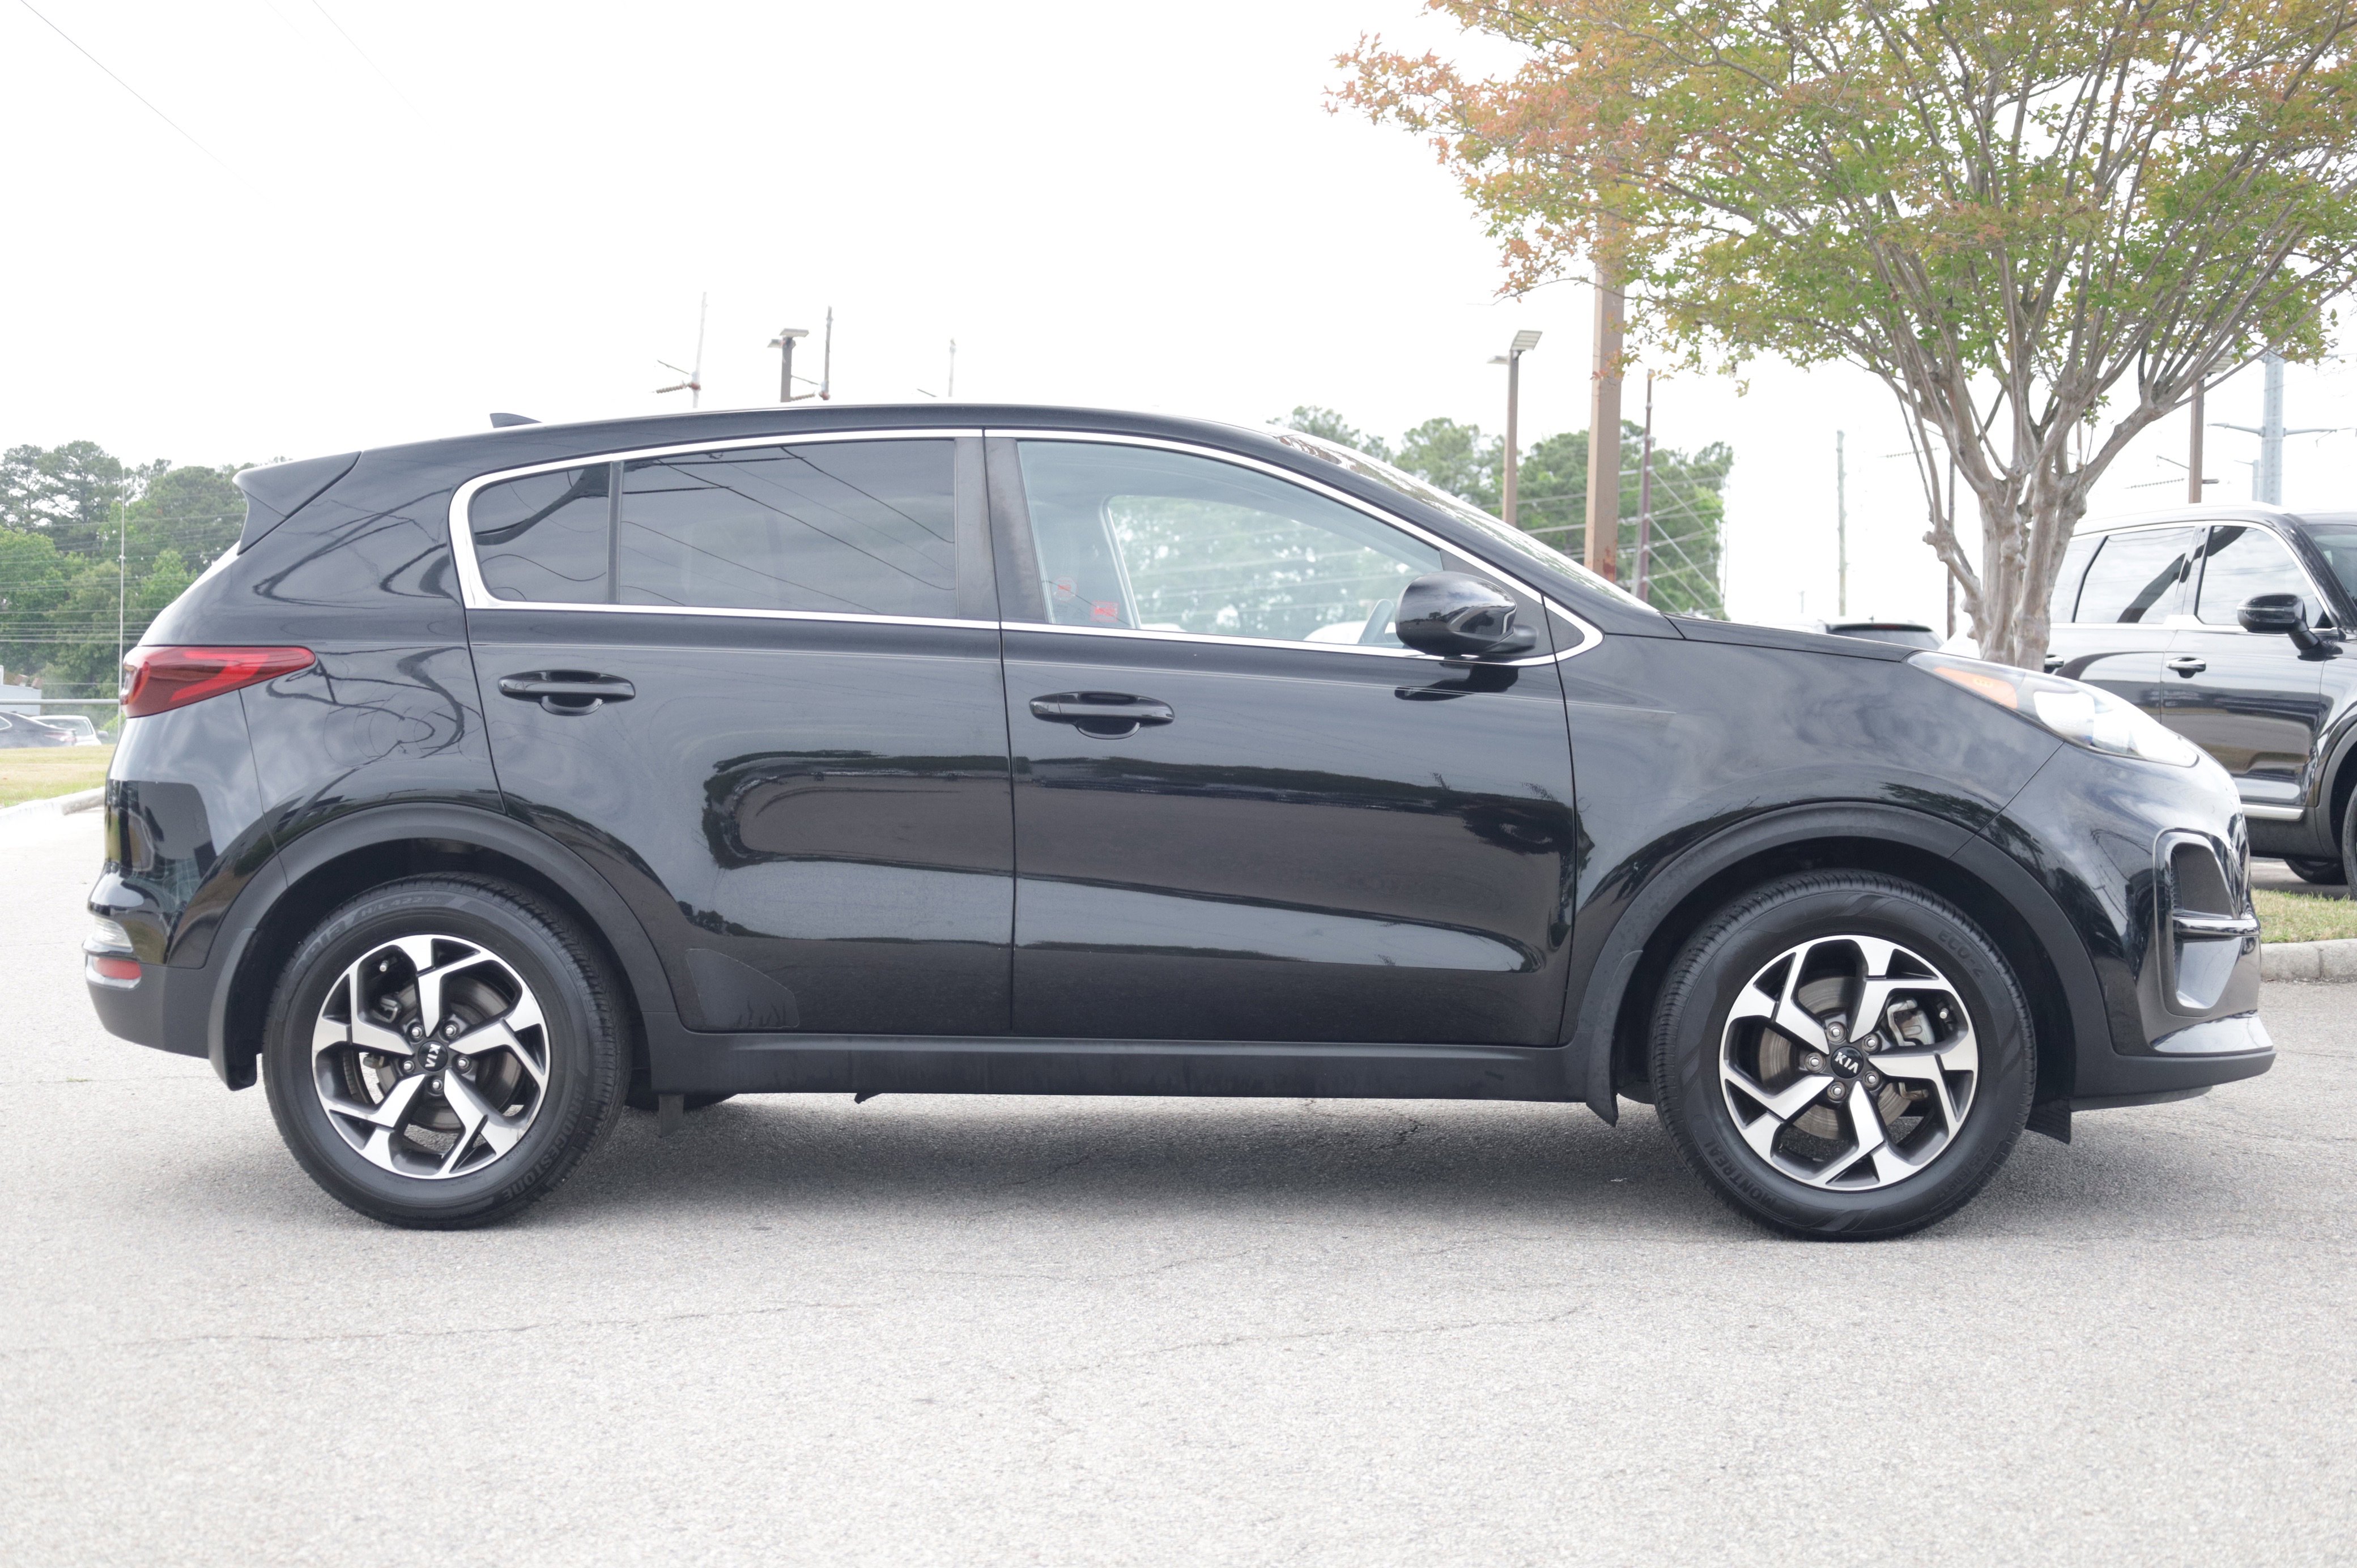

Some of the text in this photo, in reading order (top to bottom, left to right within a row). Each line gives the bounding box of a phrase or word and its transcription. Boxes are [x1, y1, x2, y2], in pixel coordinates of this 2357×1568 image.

[392, 896, 423, 906] 422
[425, 1043, 441, 1067] KIA
[1835, 1051, 1858, 1074] KIA
[501, 1083, 586, 1201] BRIDGESTONE
[1704, 1137, 1777, 1205] MONTREAL
